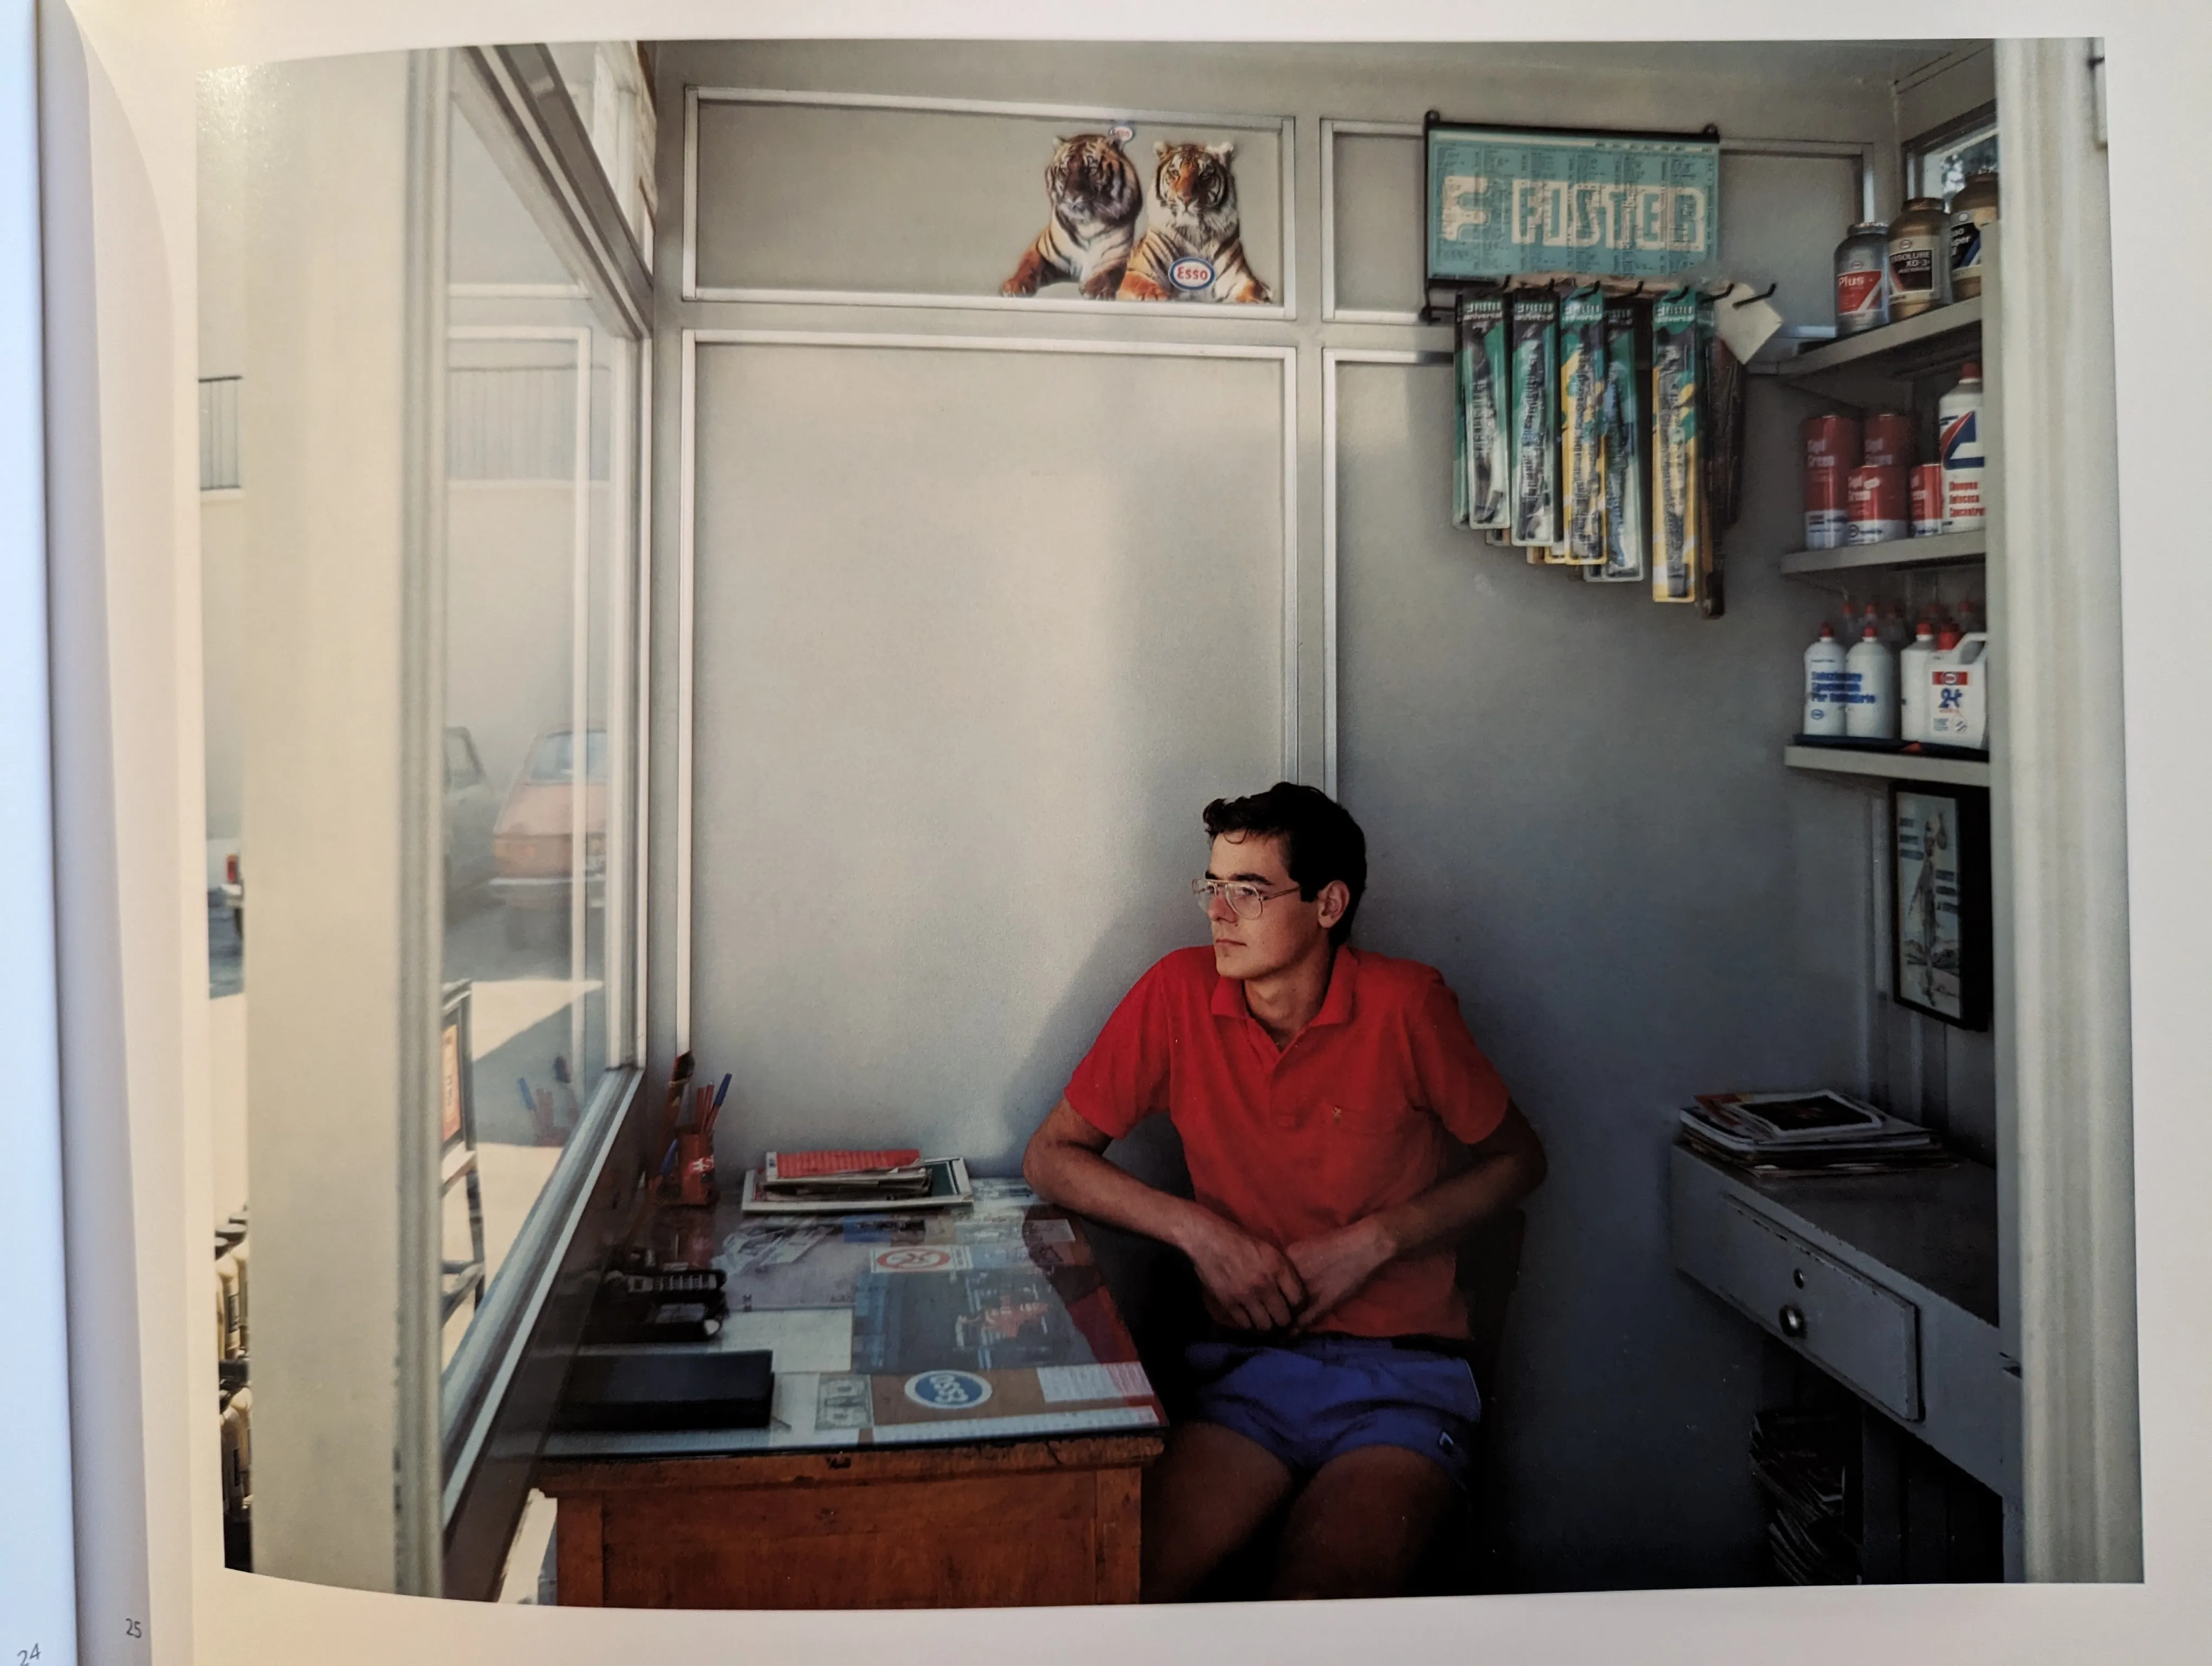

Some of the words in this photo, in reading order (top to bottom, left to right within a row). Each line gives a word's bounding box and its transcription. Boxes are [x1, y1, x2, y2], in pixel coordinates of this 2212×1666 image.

[1838, 275, 1864, 287] Plus
[125, 1618, 142, 1638] 25
[16, 1642, 42, 1666] 24
